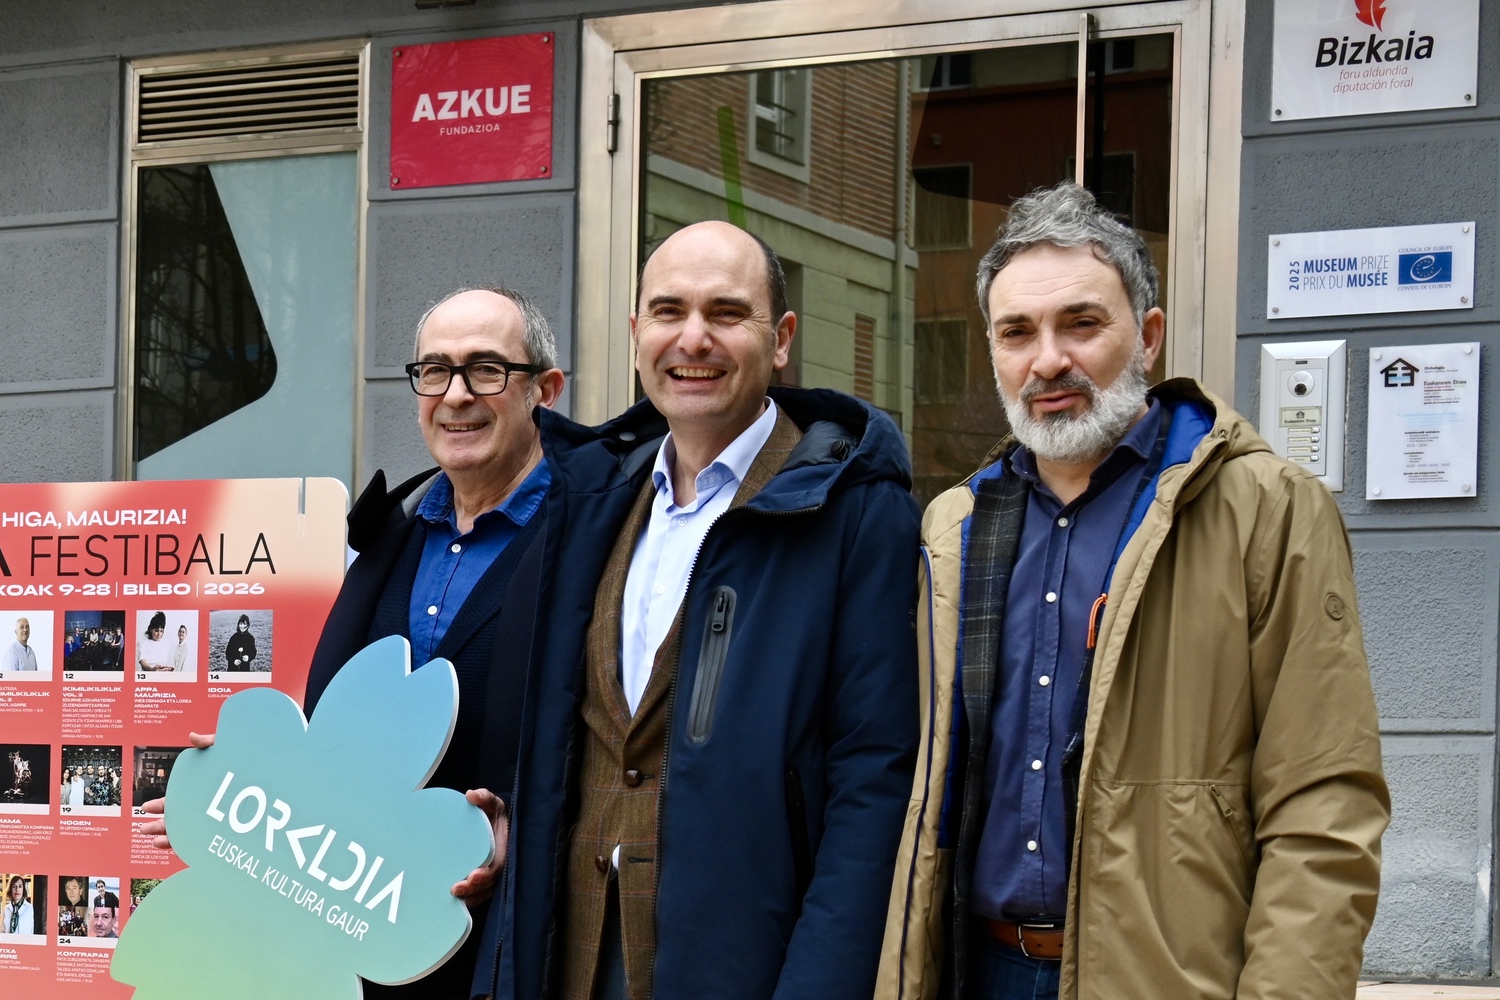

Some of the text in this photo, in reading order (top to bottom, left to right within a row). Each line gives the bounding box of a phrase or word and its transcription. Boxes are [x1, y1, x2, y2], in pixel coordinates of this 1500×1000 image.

[1315, 30, 1435, 67] Bizkaia
[1339, 65, 1408, 81] foru aldundia
[1333, 77, 1414, 94] diputación foral
[411, 84, 531, 123] AZKUE
[439, 123, 501, 136] FUNDAZIOA
[1303, 255, 1389, 273] MUSEUM PRIZE
[1289, 260, 1300, 291] 2025
[1303, 269, 1388, 291] PRIX DU MUSÉE
[2, 511, 62, 529] HIGA,
[67, 509, 187, 526] MAURIZIA!
[30, 532, 276, 577] FESTIBALA
[58, 584, 111, 596] 9-28
[123, 583, 191, 596] BILBO
[203, 582, 265, 595] 2026
[205, 770, 405, 925] LORALDIA
[208, 834, 259, 879] EUSKAL
[261, 865, 324, 918] KULTURA
[326, 905, 369, 942] GAUR
